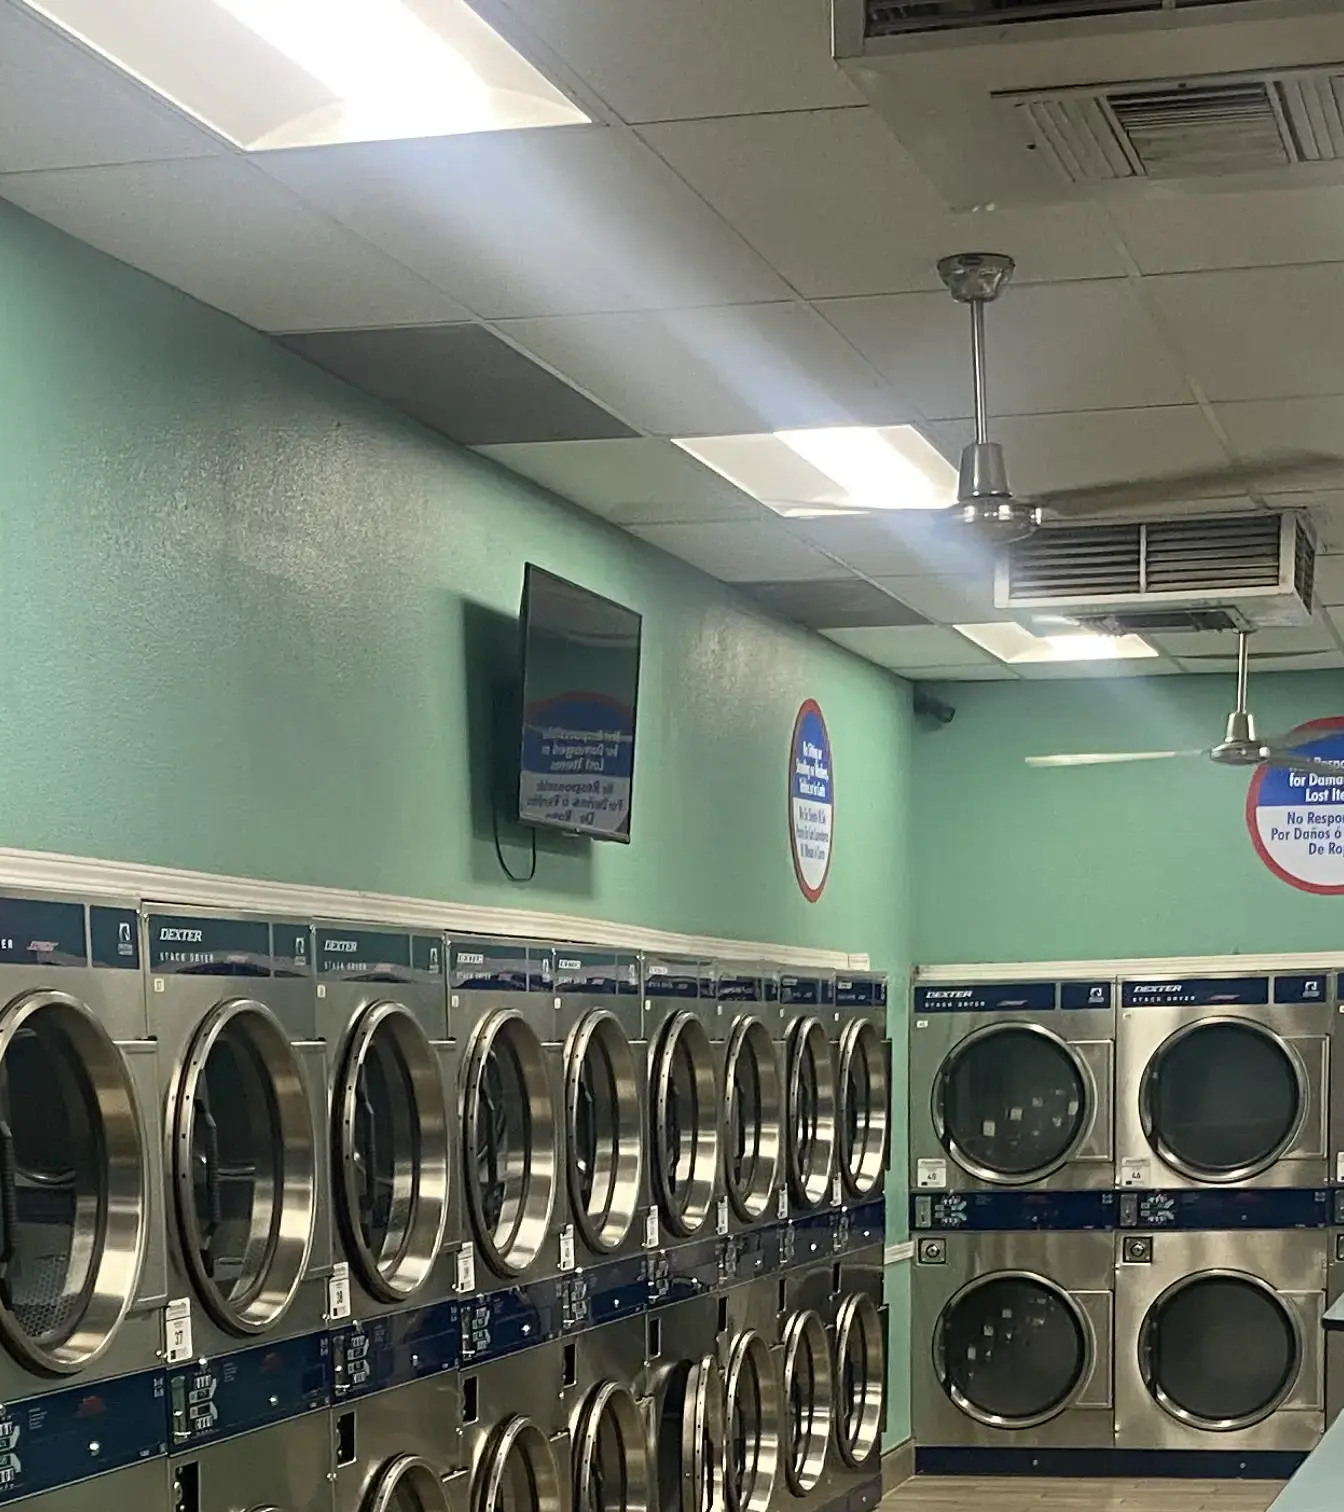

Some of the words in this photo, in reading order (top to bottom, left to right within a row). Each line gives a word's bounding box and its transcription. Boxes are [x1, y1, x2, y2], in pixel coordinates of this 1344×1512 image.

[1289, 772, 1306, 787] for
[1305, 788, 1329, 802] Lost
[1287, 812, 1304, 825] No
[1271, 828, 1289, 840] Por
[1294, 827, 1330, 840] Daños
[1308, 843, 1324, 855] De
[159, 928, 202, 942] DEXTER
[324, 939, 357, 953] DEXTER
[926, 990, 973, 998] DEXTER
[1133, 984, 1182, 993] DEXTER
